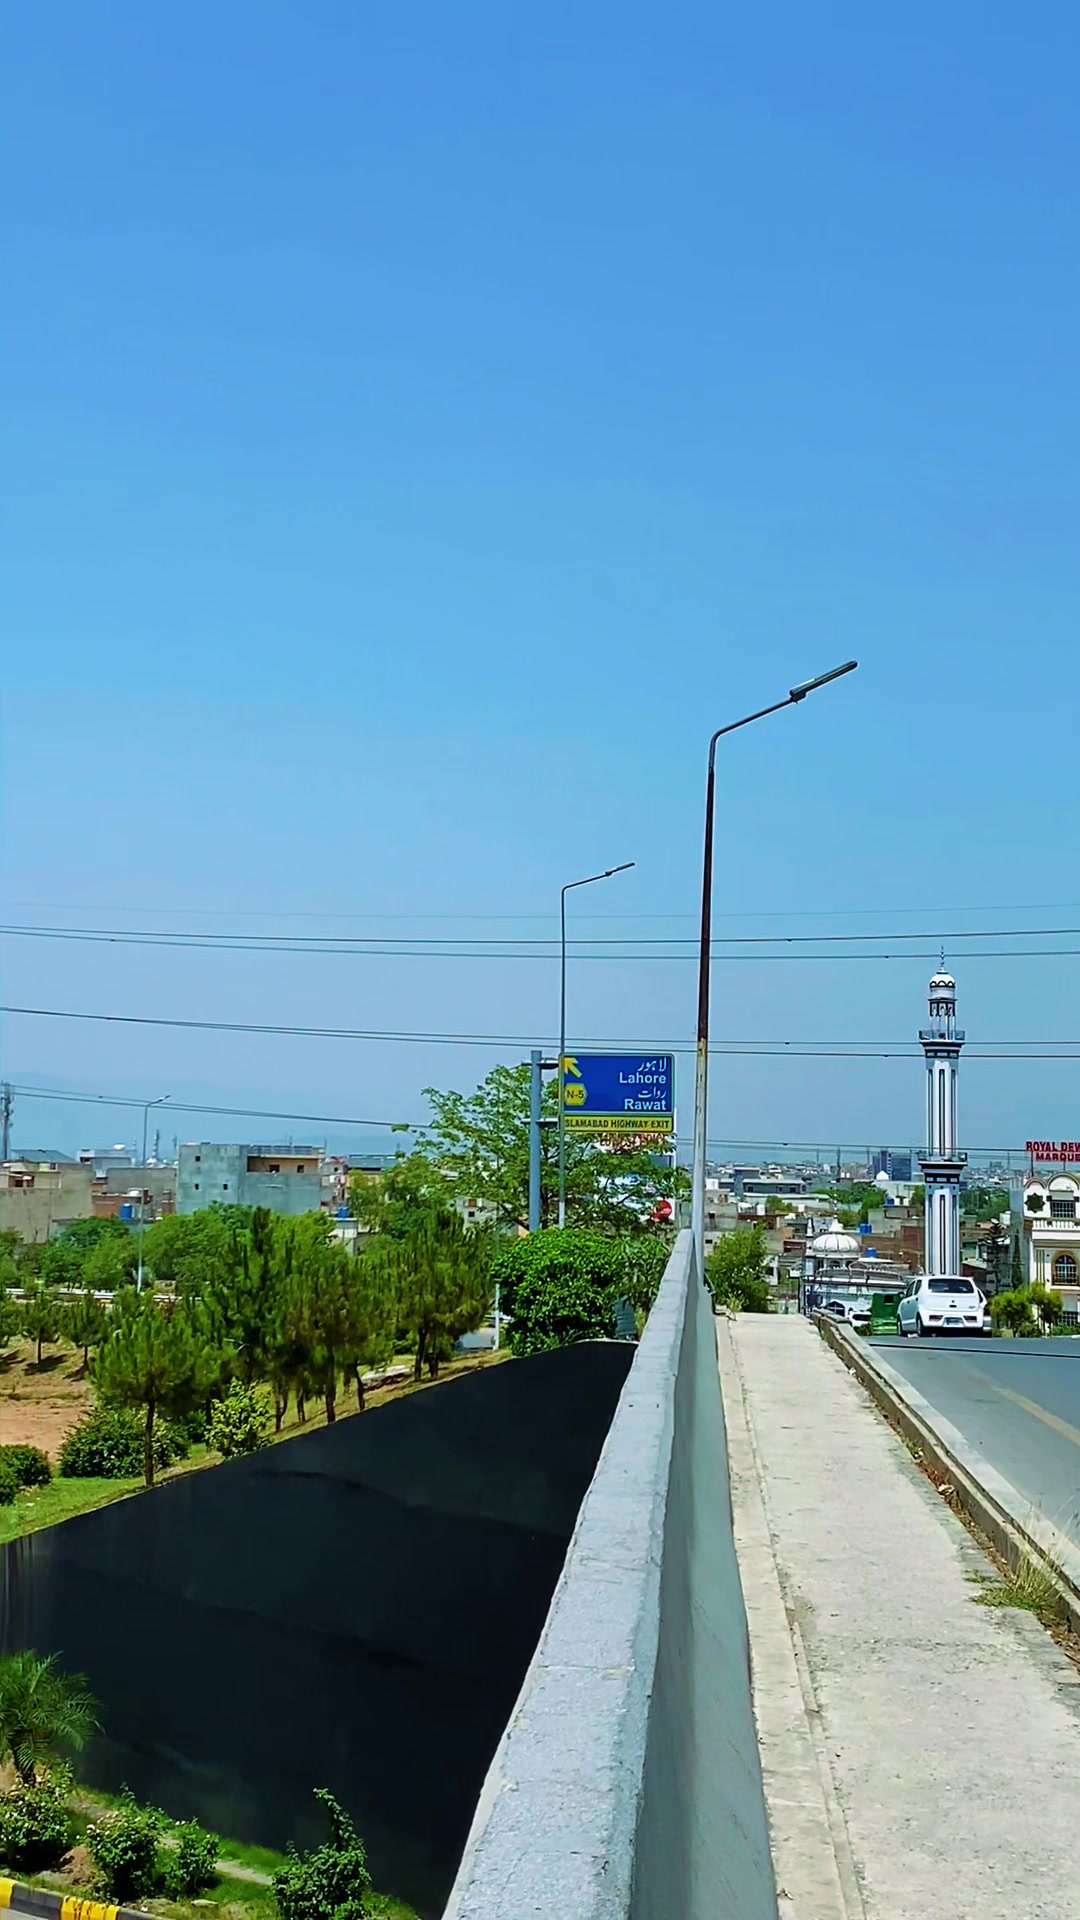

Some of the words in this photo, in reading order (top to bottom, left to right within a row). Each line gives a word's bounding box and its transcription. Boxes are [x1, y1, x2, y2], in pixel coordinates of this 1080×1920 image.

[638, 1057, 667, 1072] لاہور
[619, 1071, 667, 1084] Lahore
[566, 1089, 584, 1099] N-5
[624, 1098, 667, 1110] Rawat
[565, 1119, 609, 1128] SLAMABAD
[610, 1119, 648, 1128] HIGHWAY
[650, 1120, 670, 1128] EXIT
[1026, 1141, 1058, 1152] ROYAL
